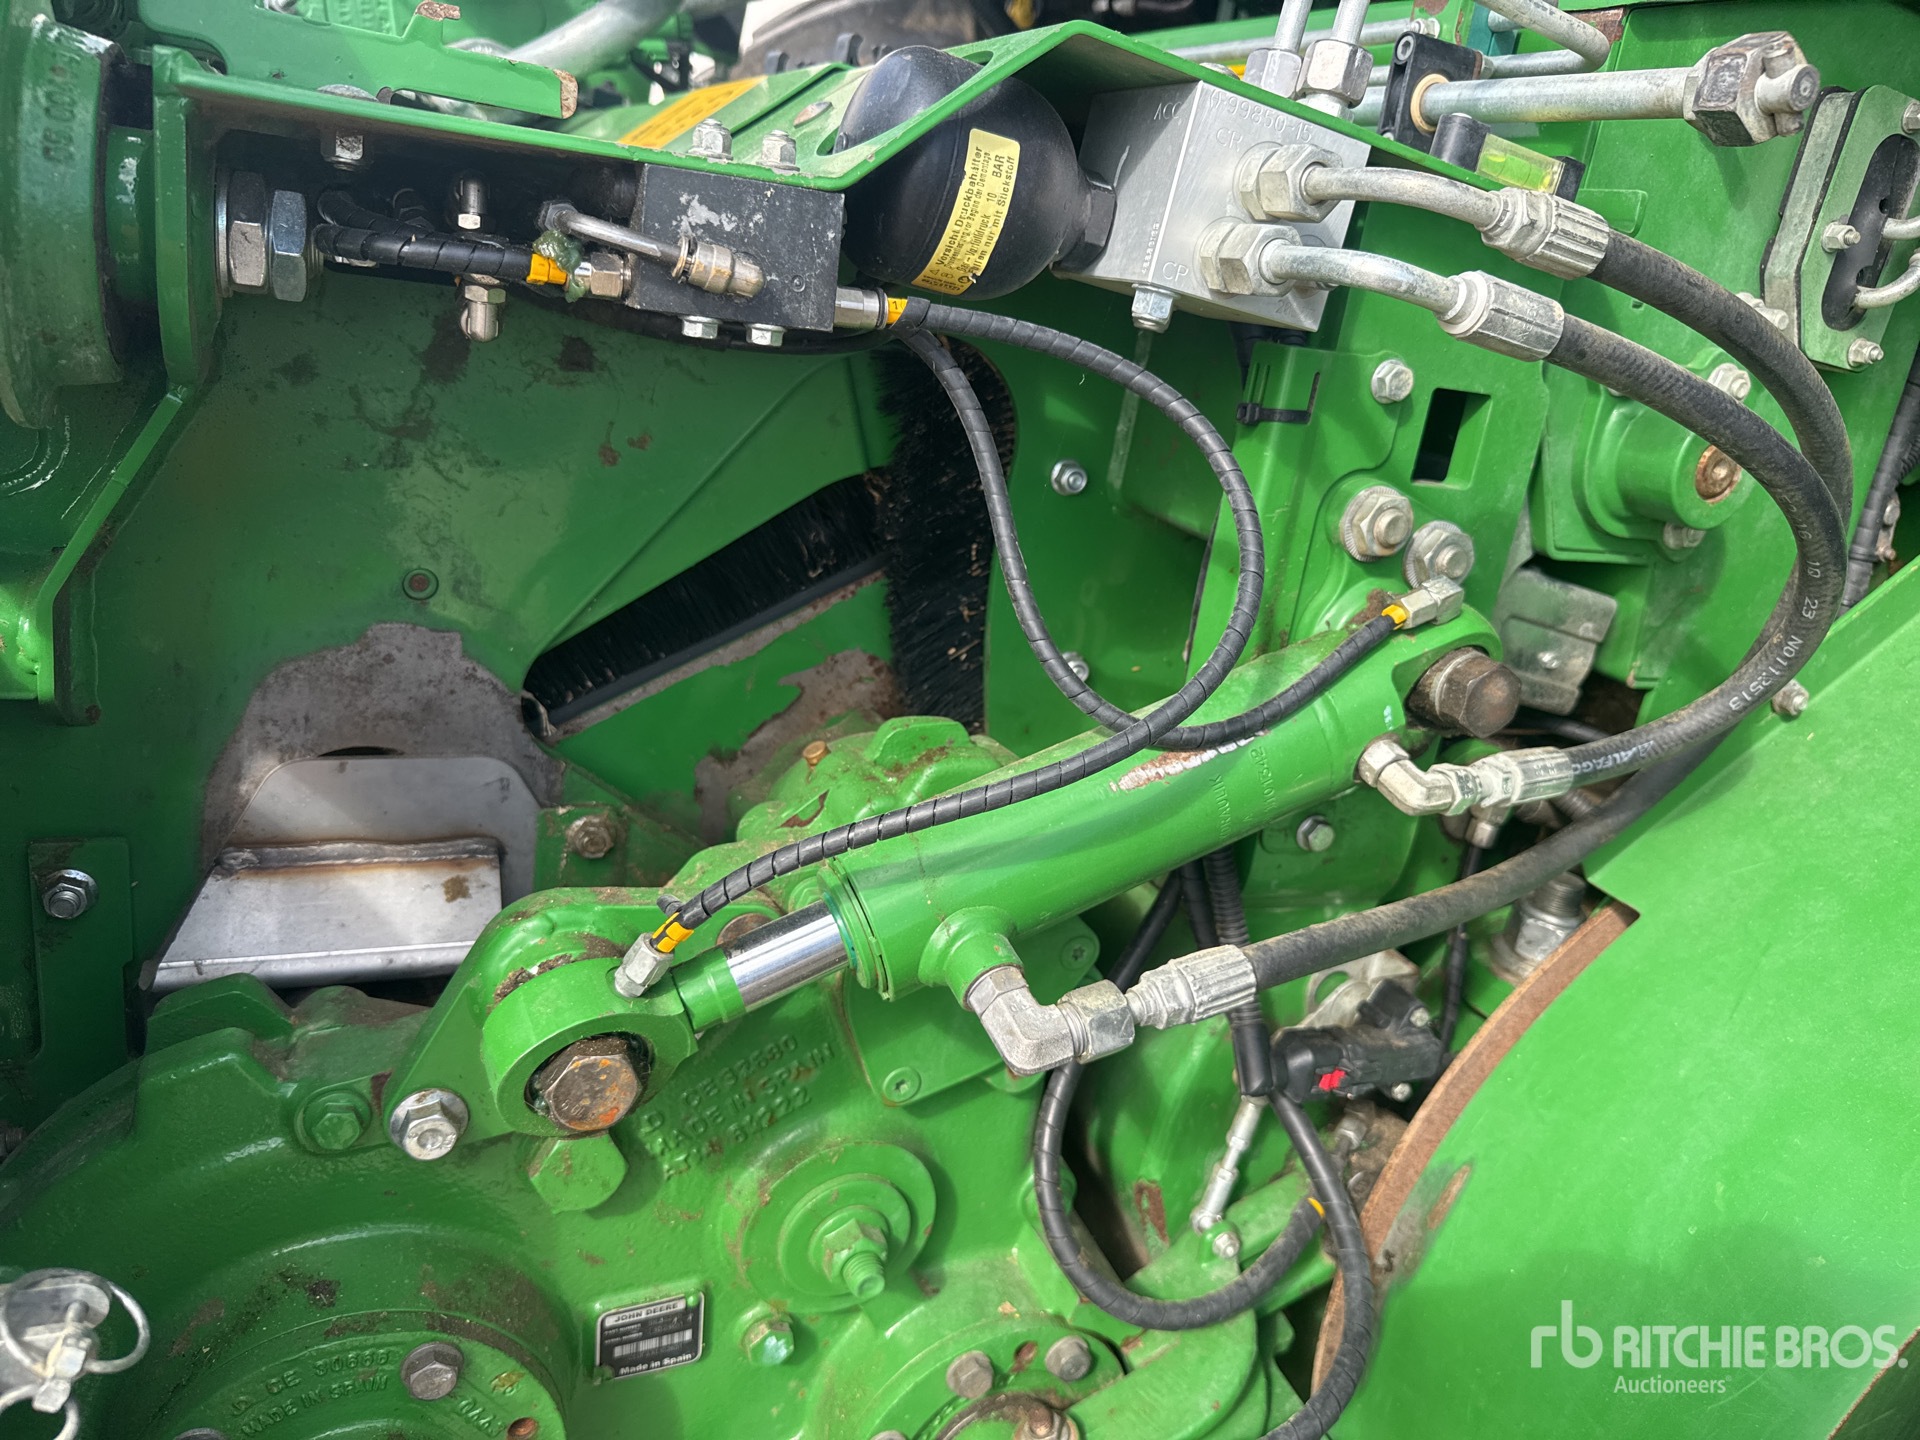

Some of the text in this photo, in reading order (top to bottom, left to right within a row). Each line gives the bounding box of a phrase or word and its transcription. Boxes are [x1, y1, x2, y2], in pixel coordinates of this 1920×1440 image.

[1153, 101, 1182, 121] ACC
[1215, 127, 1244, 152] CR
[986, 192, 998, 204] 10
[992, 155, 1006, 179] BAR
[997, 156, 1016, 208] Stickstoff
[992, 210, 1004, 230] mit
[935, 227, 961, 266] Vorsicht
[983, 227, 996, 248] nur
[1162, 261, 1189, 282] CP
[1802, 598, 1819, 620] 23
[614, 1302, 679, 1323] JOHN DEERE
[619, 1353, 692, 1375] Made in Spain
[241, 1374, 389, 1437] MADE IN SPAIN
